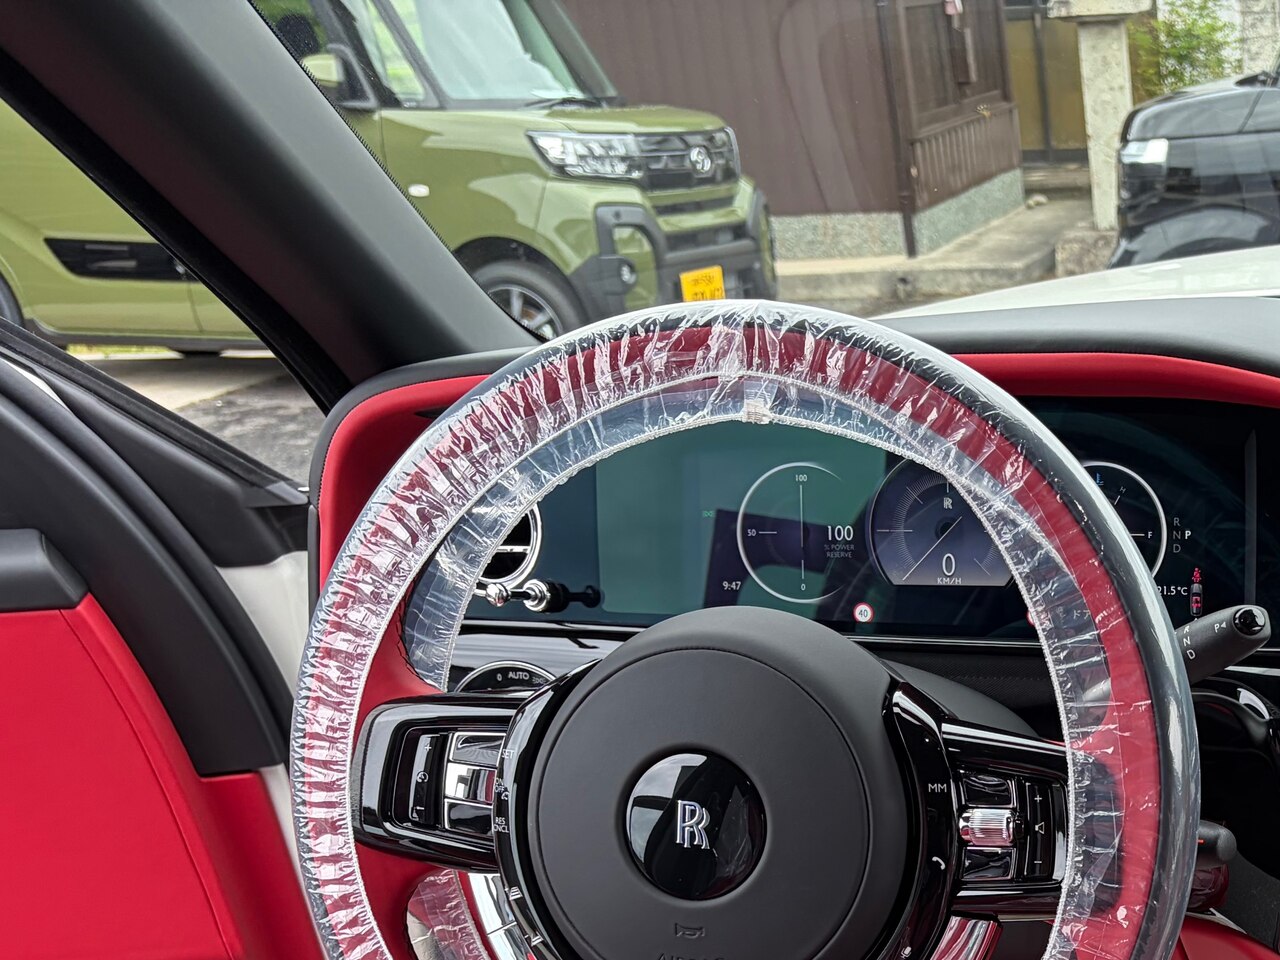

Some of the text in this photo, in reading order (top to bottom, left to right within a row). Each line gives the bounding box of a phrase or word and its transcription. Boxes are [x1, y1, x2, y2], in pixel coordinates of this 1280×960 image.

[795, 474, 808, 482] 100
[1173, 517, 1180, 527] R
[747, 529, 757, 537] 50
[827, 525, 854, 541] 100
[1147, 531, 1153, 539] F
[1172, 530, 1192, 540] N P
[831, 543, 855, 551] POWER
[1173, 544, 1181, 553] D
[826, 551, 853, 559] RESERVE
[942, 553, 956, 576] 0
[722, 581, 742, 591] 9:47
[937, 577, 962, 585] KM/H
[800, 583, 806, 591] 0
[858, 608, 869, 618] 40
[1214, 623, 1220, 633] P
[1183, 636, 1191, 647] N
[1186, 649, 1196, 660] D
[508, 671, 530, 680] AUTO
[501, 748, 515, 759] SET
[928, 783, 947, 793] MM
[495, 816, 506, 825] RES
